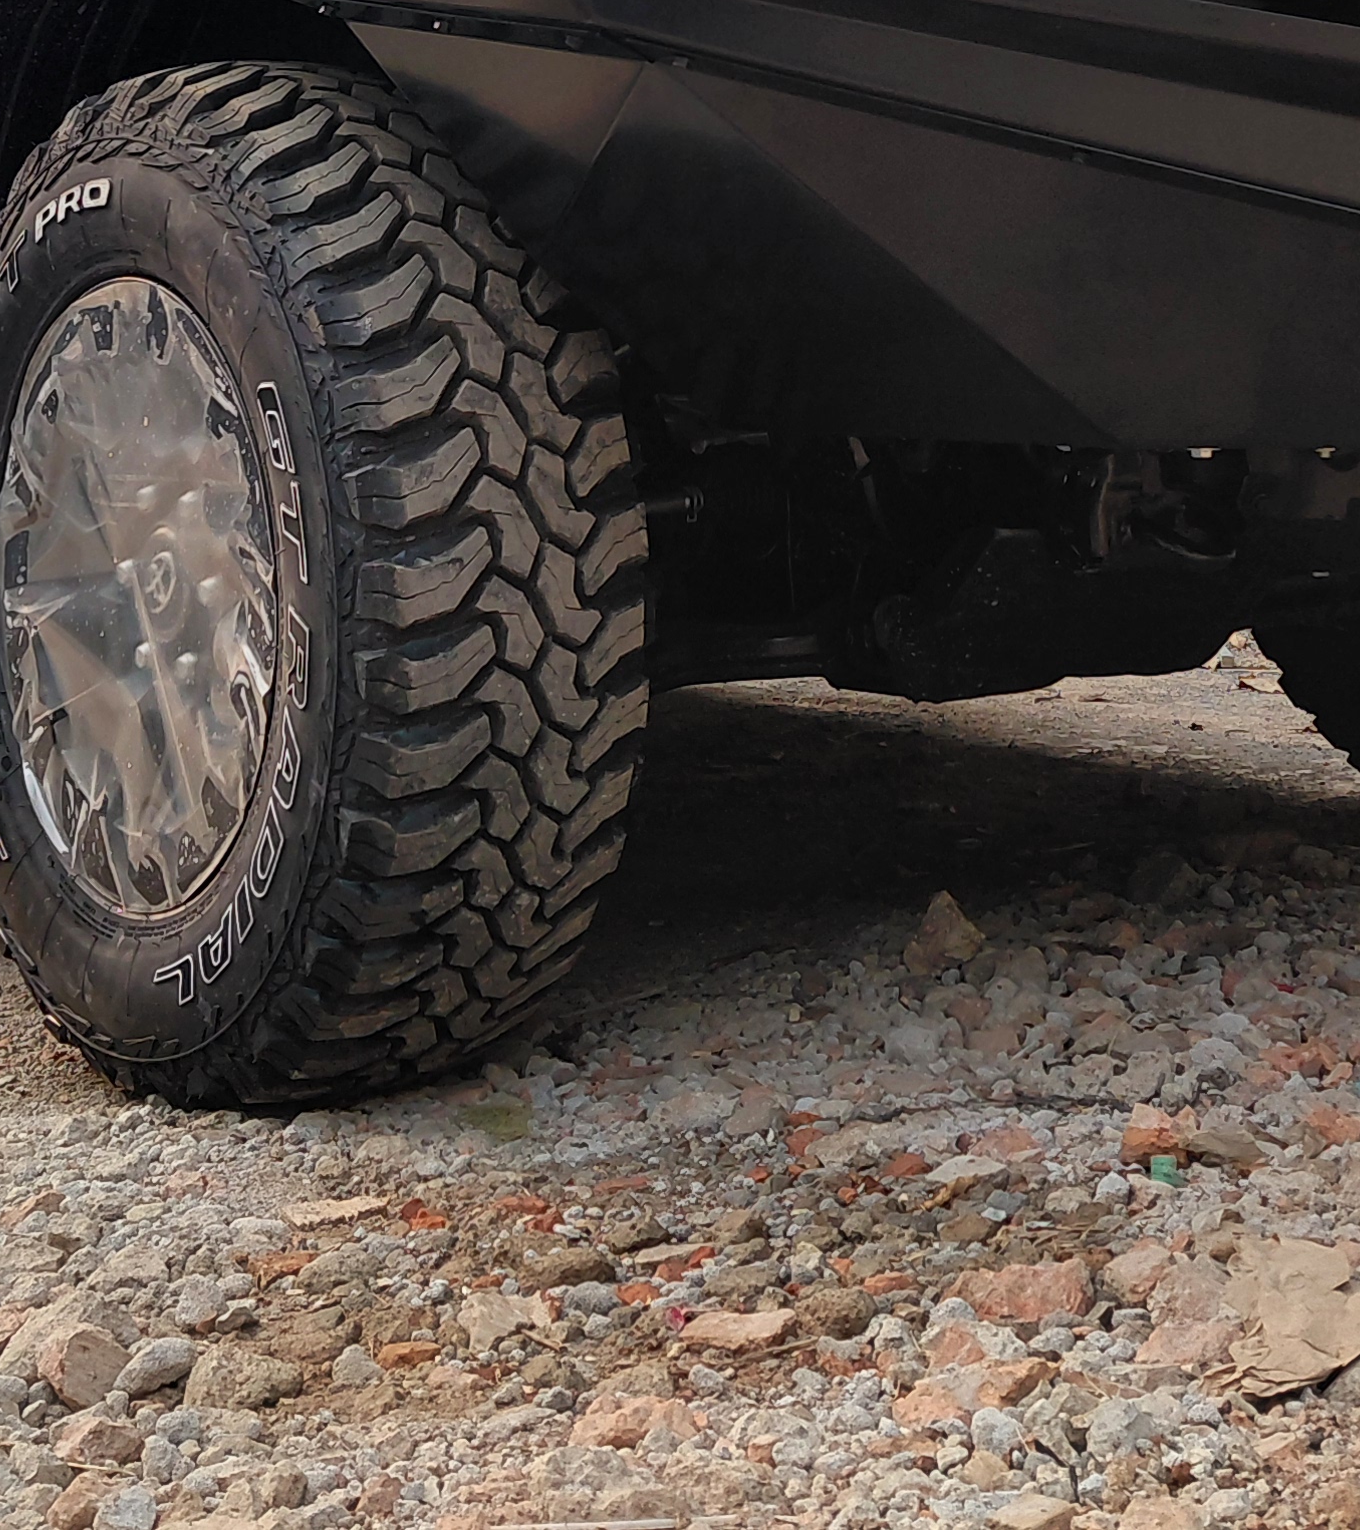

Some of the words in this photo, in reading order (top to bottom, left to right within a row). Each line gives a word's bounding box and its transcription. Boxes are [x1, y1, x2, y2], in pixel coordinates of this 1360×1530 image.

[34, 176, 112, 244] PRO
[256, 381, 310, 585] GT
[153, 605, 311, 1007] RADIAL
